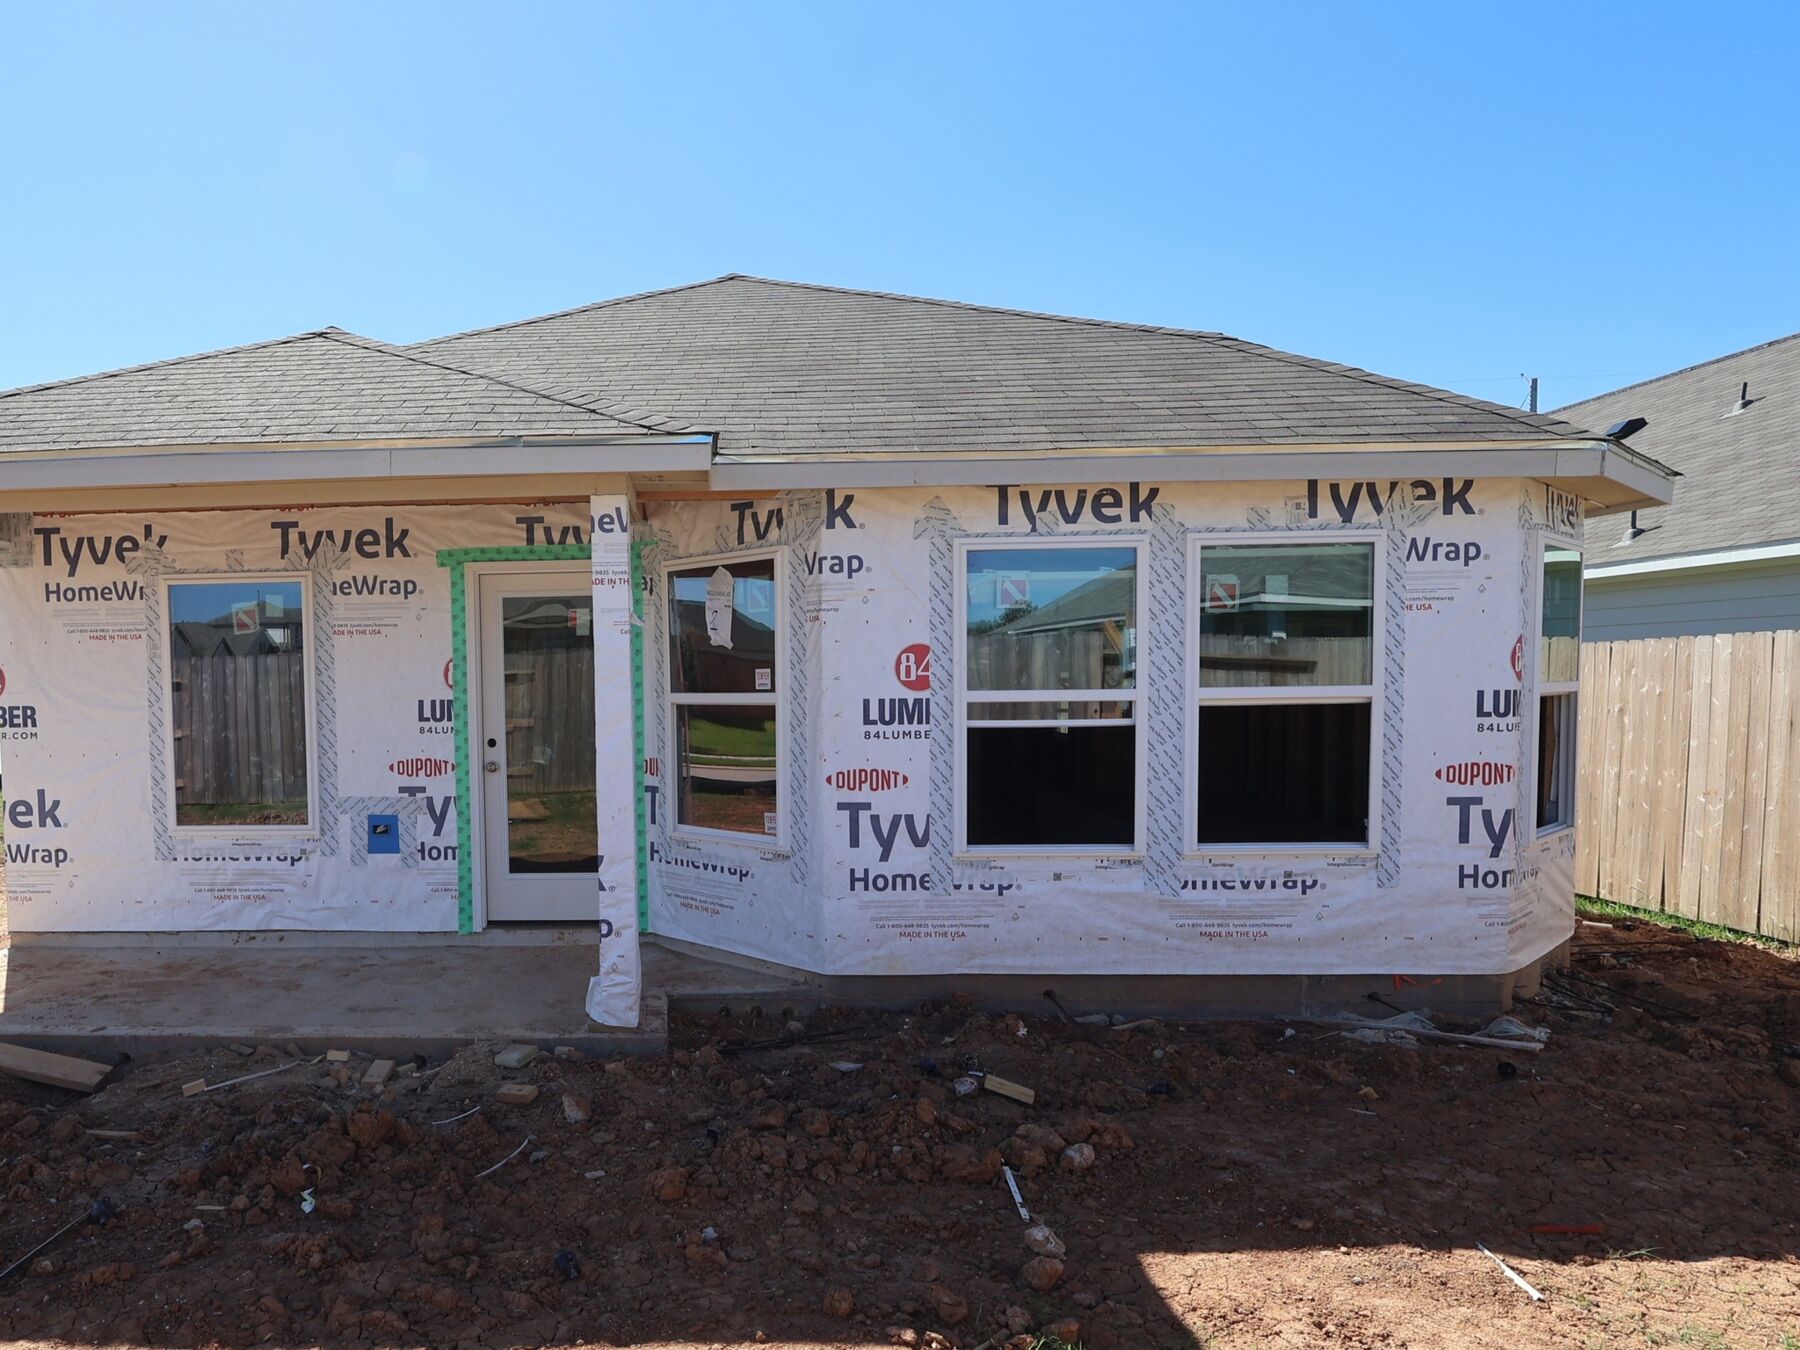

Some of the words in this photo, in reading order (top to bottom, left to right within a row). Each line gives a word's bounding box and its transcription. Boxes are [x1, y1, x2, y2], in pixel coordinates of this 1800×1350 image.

[985, 481, 1160, 533] Tyvek
[129, 633, 143, 641] USA
[368, 628, 382, 636] USA
[397, 758, 449, 778] DUPONT
[1445, 762, 1514, 786] DUPONT
[836, 768, 900, 792] DUPONT
[950, 931, 966, 939] USA
